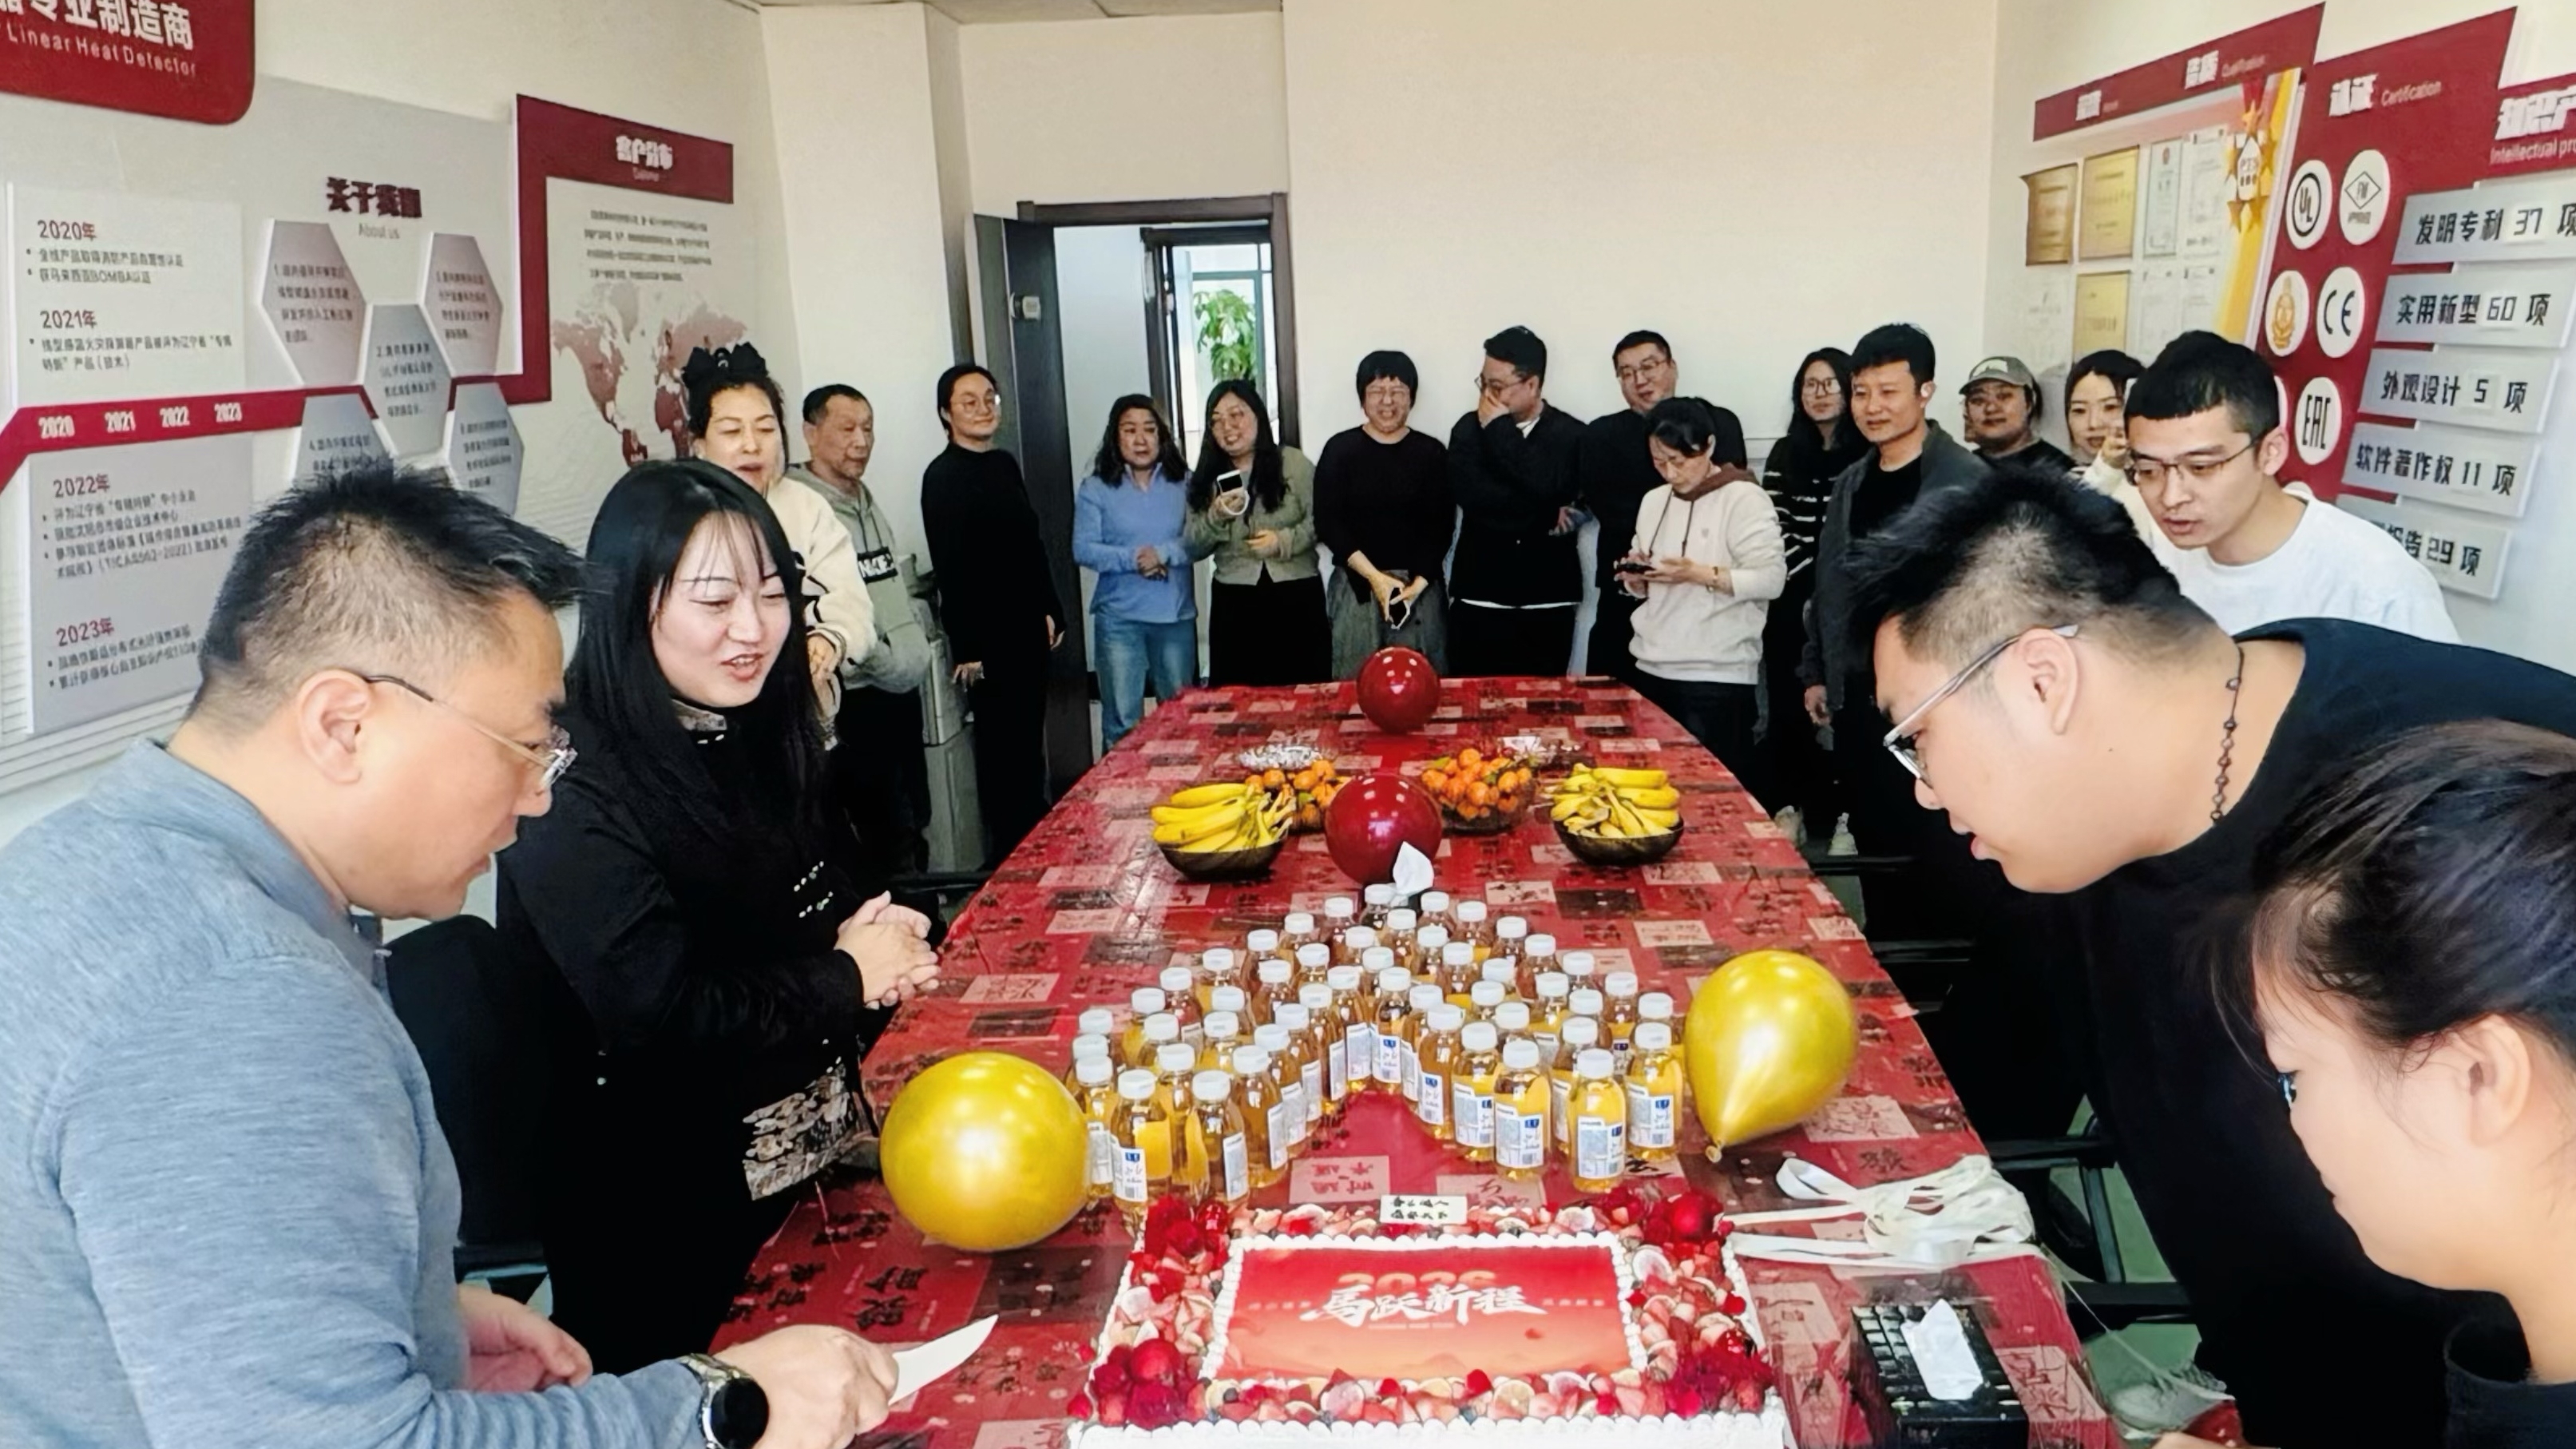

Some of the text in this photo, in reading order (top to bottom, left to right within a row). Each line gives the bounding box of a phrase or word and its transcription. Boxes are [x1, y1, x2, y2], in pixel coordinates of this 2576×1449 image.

[6, 20, 196, 77] Linear Heat Detector
[2380, 80, 2442, 106] Certification
[2489, 137, 2558, 165] Intellectual
[2299, 186, 2312, 223] UL
[38, 220, 97, 241] 2020年
[2415, 208, 2504, 245] 发明专利
[2513, 208, 2543, 236] 37
[39, 309, 97, 329] 2021年
[2324, 289, 2356, 337] CE
[2396, 293, 2551, 326] 实用新型 60 项
[2380, 370, 2529, 414] 外观设计 5 项
[38, 402, 243, 439] 2020 2021 2022 2023
[54, 473, 111, 498] 2022年
[2354, 442, 2517, 497] 软件著作权 11 项
[2426, 537, 2456, 566] 29
[2459, 545, 2483, 577] 项
[55, 616, 115, 647] 2023年
